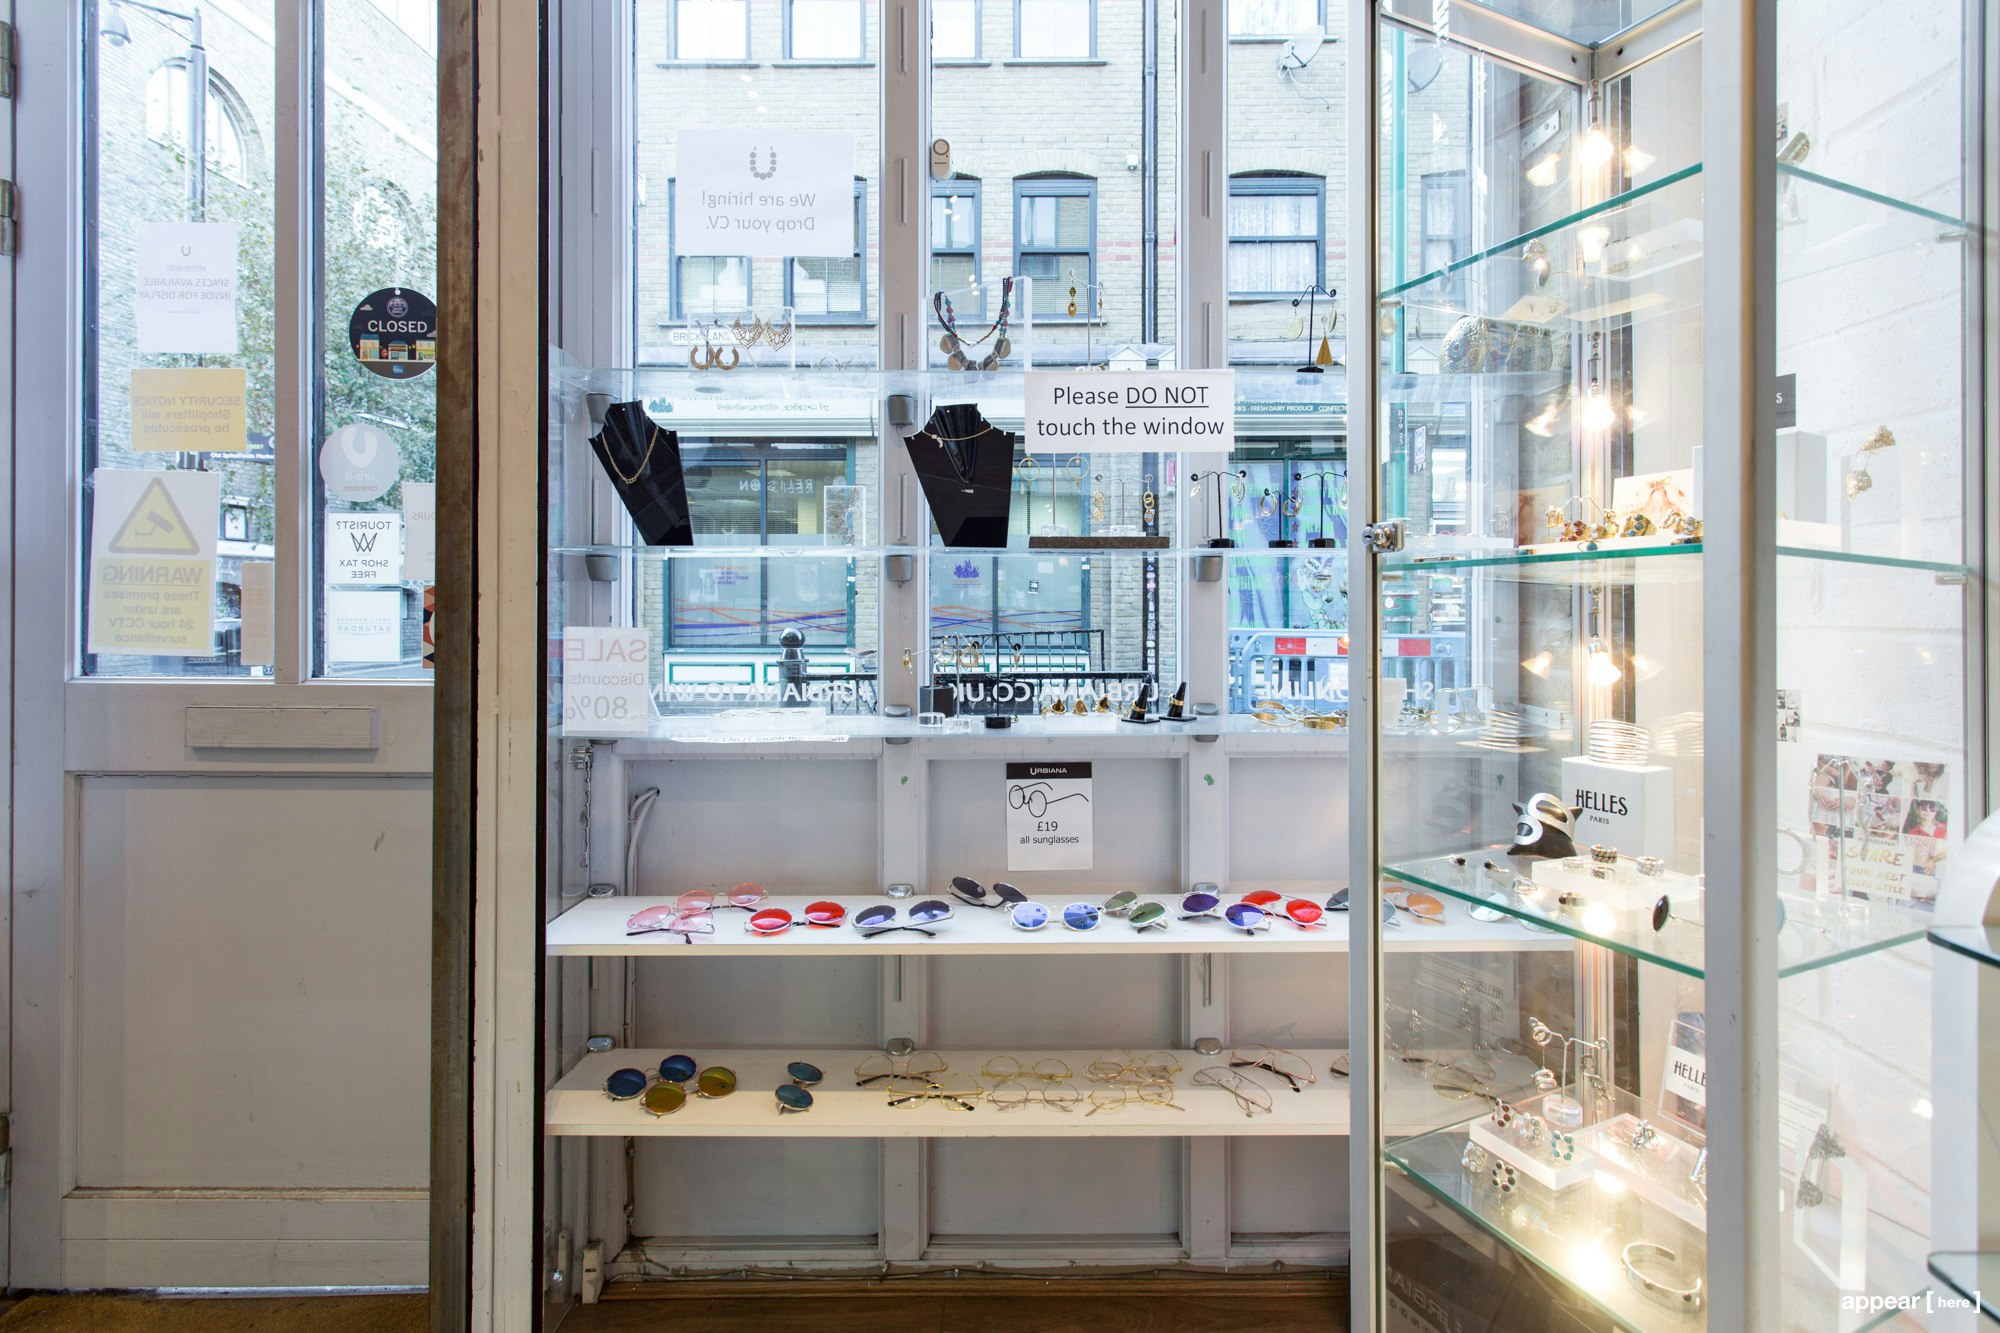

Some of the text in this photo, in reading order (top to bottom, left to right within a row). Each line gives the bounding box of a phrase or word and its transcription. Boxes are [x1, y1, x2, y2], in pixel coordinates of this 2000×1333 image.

[367, 319, 428, 333] CLOSED
[673, 332, 701, 342] BRICK
[1053, 386, 1209, 406] Please DO NOT
[1037, 417, 1226, 437] touch the window
[1029, 767, 1068, 776] URBIANA
[1575, 788, 1629, 816] HELLES
[1589, 815, 1610, 825] PARIS
[1036, 821, 1058, 832] £19
[1019, 835, 1080, 845] all sunglasses
[1673, 1060, 1707, 1088] HELLE
